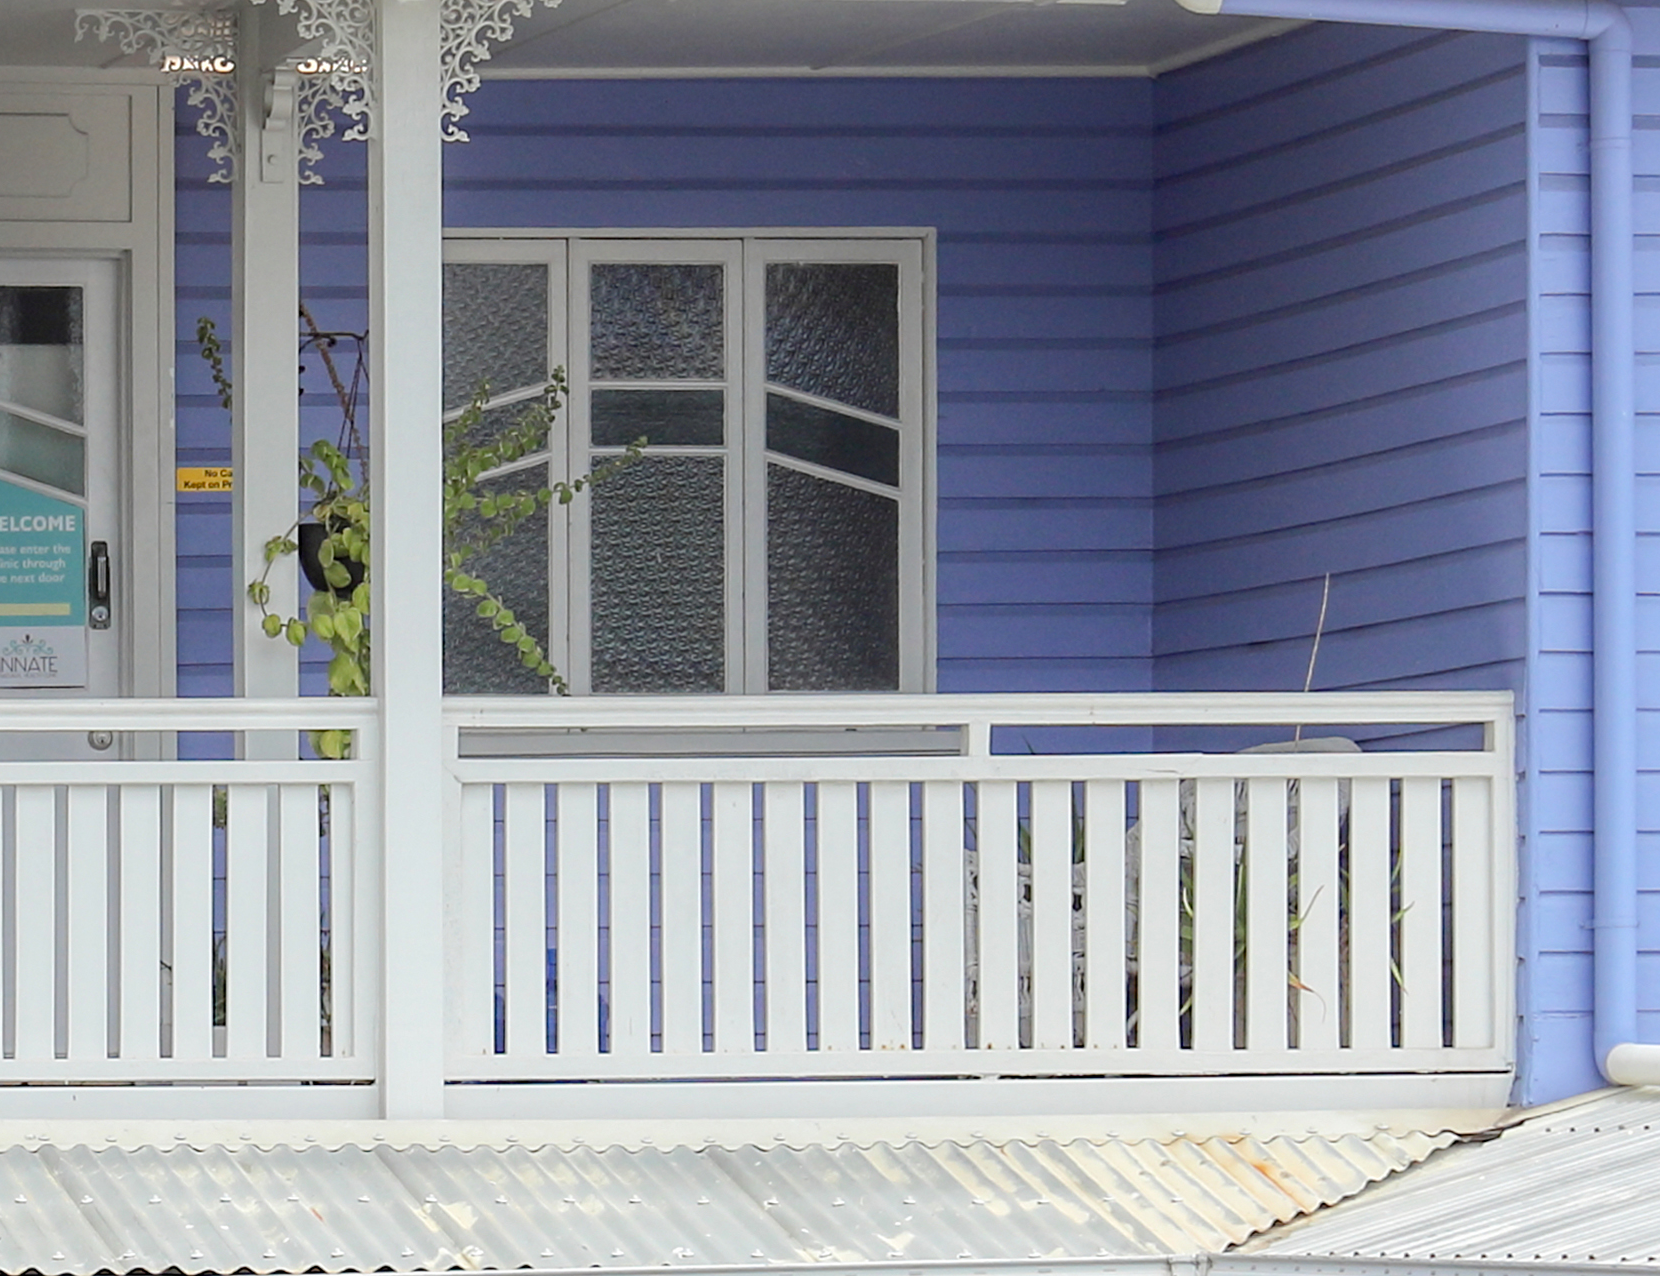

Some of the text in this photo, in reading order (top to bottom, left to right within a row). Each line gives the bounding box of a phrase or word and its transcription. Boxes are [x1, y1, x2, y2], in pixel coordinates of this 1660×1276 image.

[184, 481, 206, 490] Kept
[222, 481, 232, 489] Pr
[19, 545, 50, 554] enter
[52, 543, 71, 554] the
[22, 558, 66, 571] through
[10, 572, 35, 583] next
[38, 572, 66, 583] door
